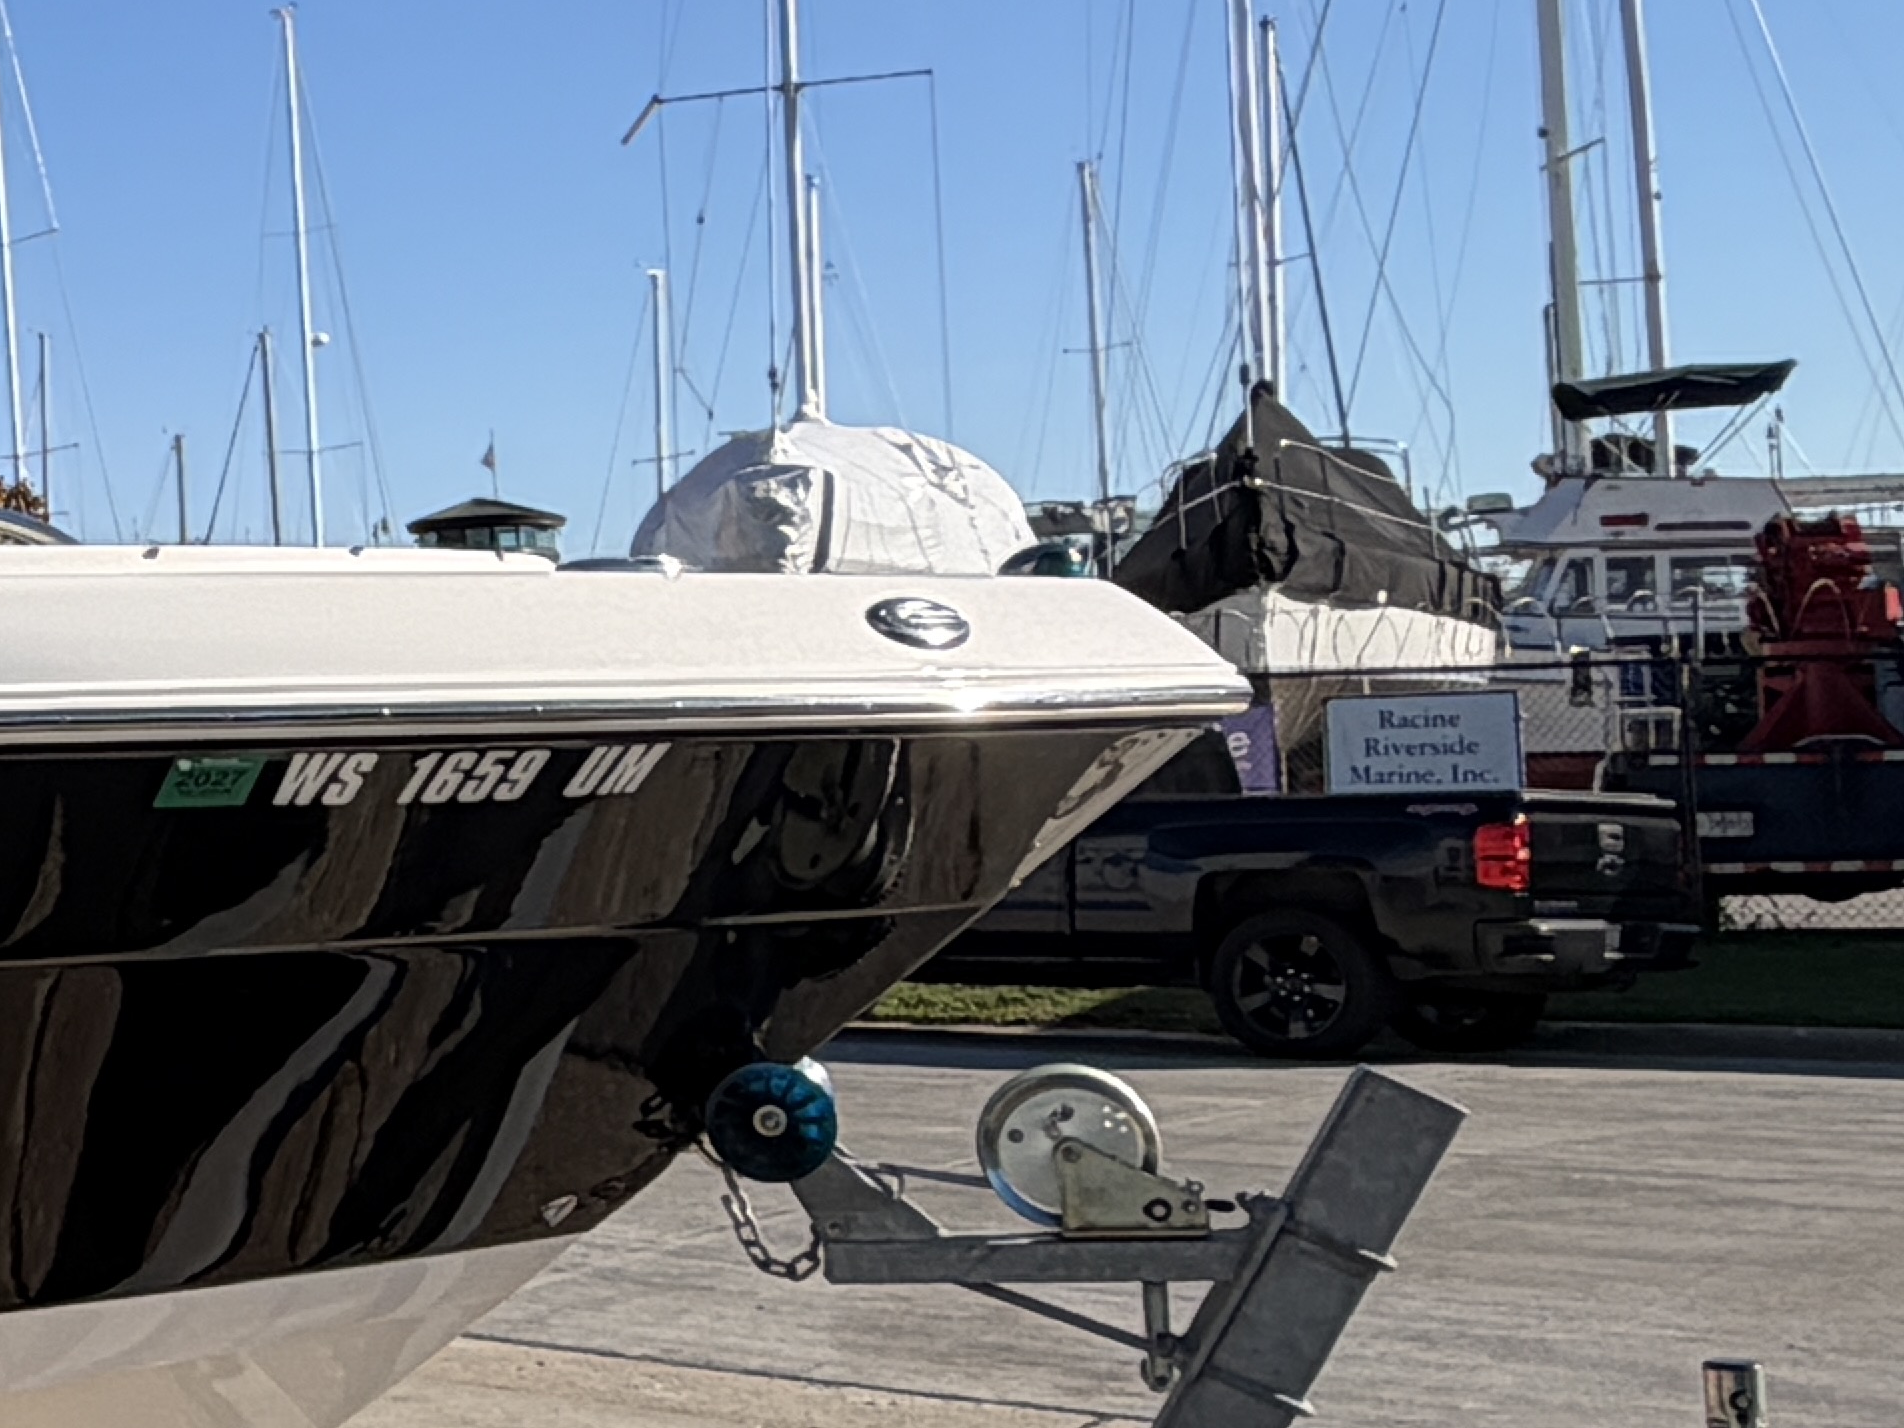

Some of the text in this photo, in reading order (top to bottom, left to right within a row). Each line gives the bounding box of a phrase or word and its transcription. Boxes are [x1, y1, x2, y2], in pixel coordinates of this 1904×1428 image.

[1378, 708, 1460, 729] Racine
[1364, 733, 1480, 758] Riverside
[272, 742, 672, 806] WS 1659 UM
[1349, 762, 1500, 785] Marine, Inc.
